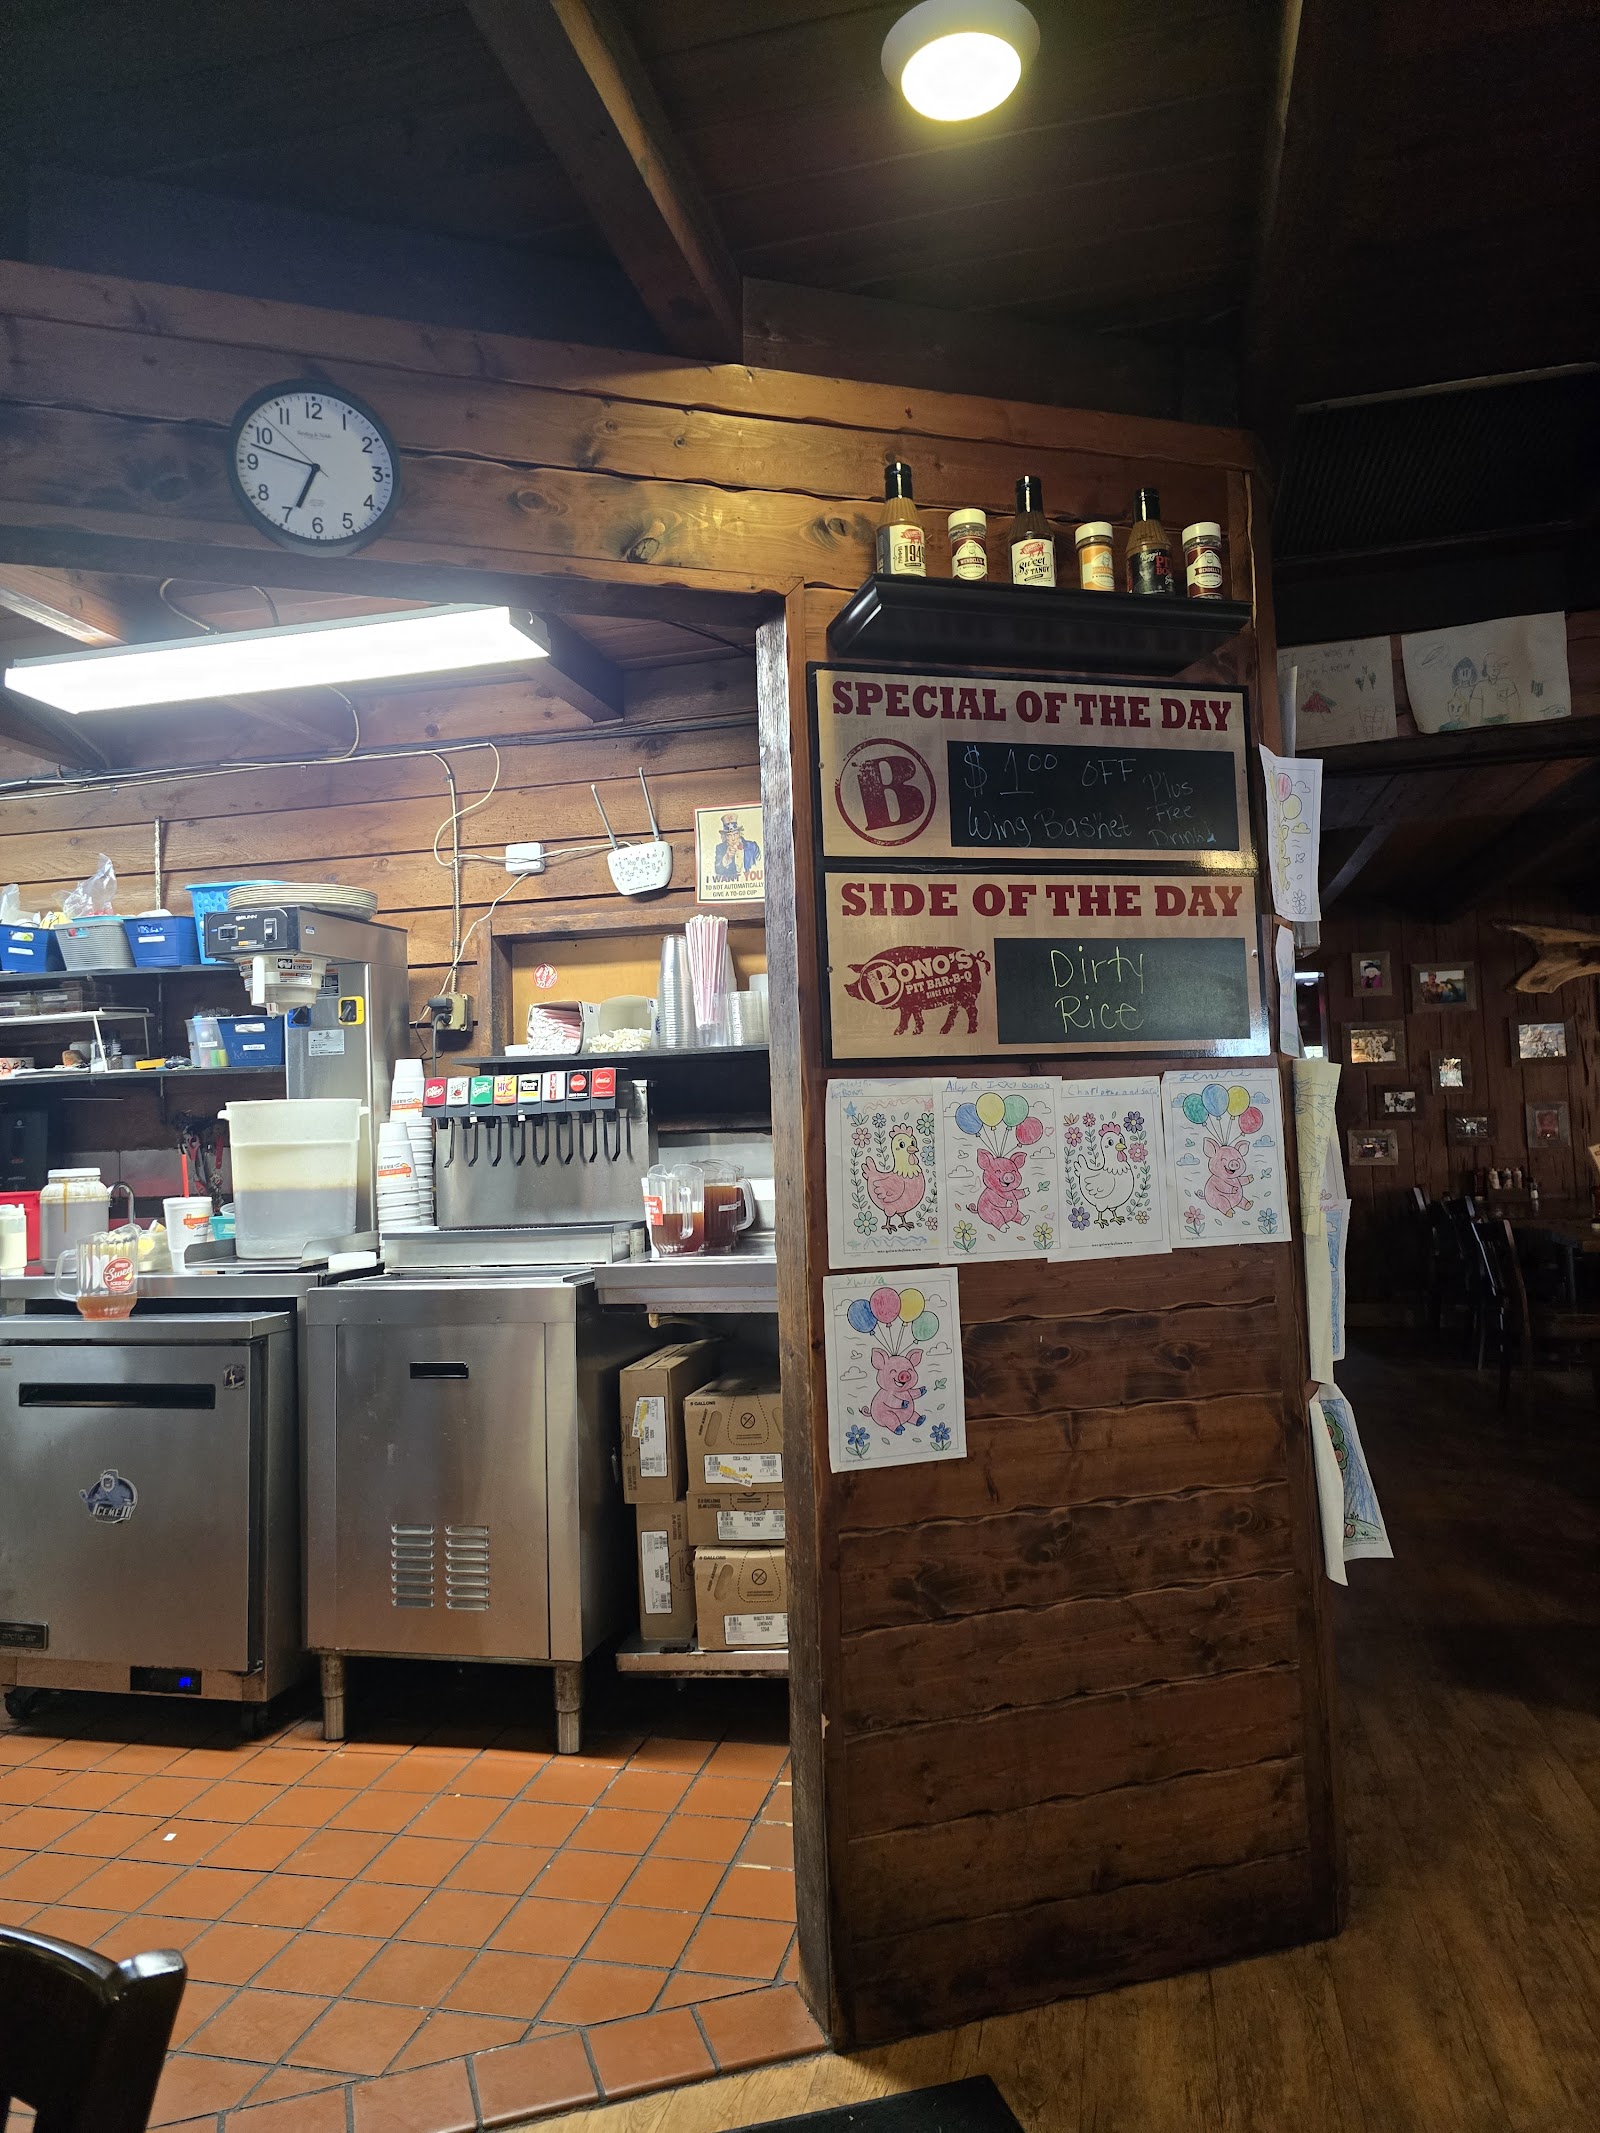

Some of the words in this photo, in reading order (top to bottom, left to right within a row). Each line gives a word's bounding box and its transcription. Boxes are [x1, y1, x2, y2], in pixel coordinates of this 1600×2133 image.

[279, 407, 290, 425] 11
[305, 401, 323, 420] 12
[342, 413, 347, 431] 1
[256, 426, 272, 445] 10
[361, 436, 373, 454] 2
[247, 453, 259, 470] 9
[372, 466, 384, 483] 3
[258, 483, 269, 501] 8
[363, 494, 375, 511] 4
[281, 506, 293, 524] 7
[342, 512, 353, 530] 5
[311, 517, 324, 534] 6
[1018, 556, 1046, 574] Sweet
[1030, 566, 1050, 575] TANGY
[832, 681, 1006, 721] SPECIAL
[1016, 690, 1070, 724] OF
[1074, 694, 1151, 727] THE
[1161, 699, 1232, 731] DAY
[855, 754, 926, 832] B
[1142, 771, 1194, 803] Plus
[1146, 802, 1195, 823] Free
[968, 806, 1032, 849] Wing
[706, 875, 710, 884] I
[712, 873, 741, 883] WANT
[743, 870, 763, 881] YOU
[724, 881, 764, 890] AUTOMATICALLY
[841, 882, 959, 917] SIDE
[972, 884, 1038, 917] OF
[1045, 884, 1142, 917] THE
[1154, 885, 1243, 917] DAY
[866, 950, 974, 1004] BONO'S
[1050, 945, 1145, 994] Dirty
[905, 981, 926, 995] PIT
[927, 971, 973, 990] BAR-B-Q
[1054, 995, 1145, 1033] Rice
[104, 1262, 134, 1282] Sweet
